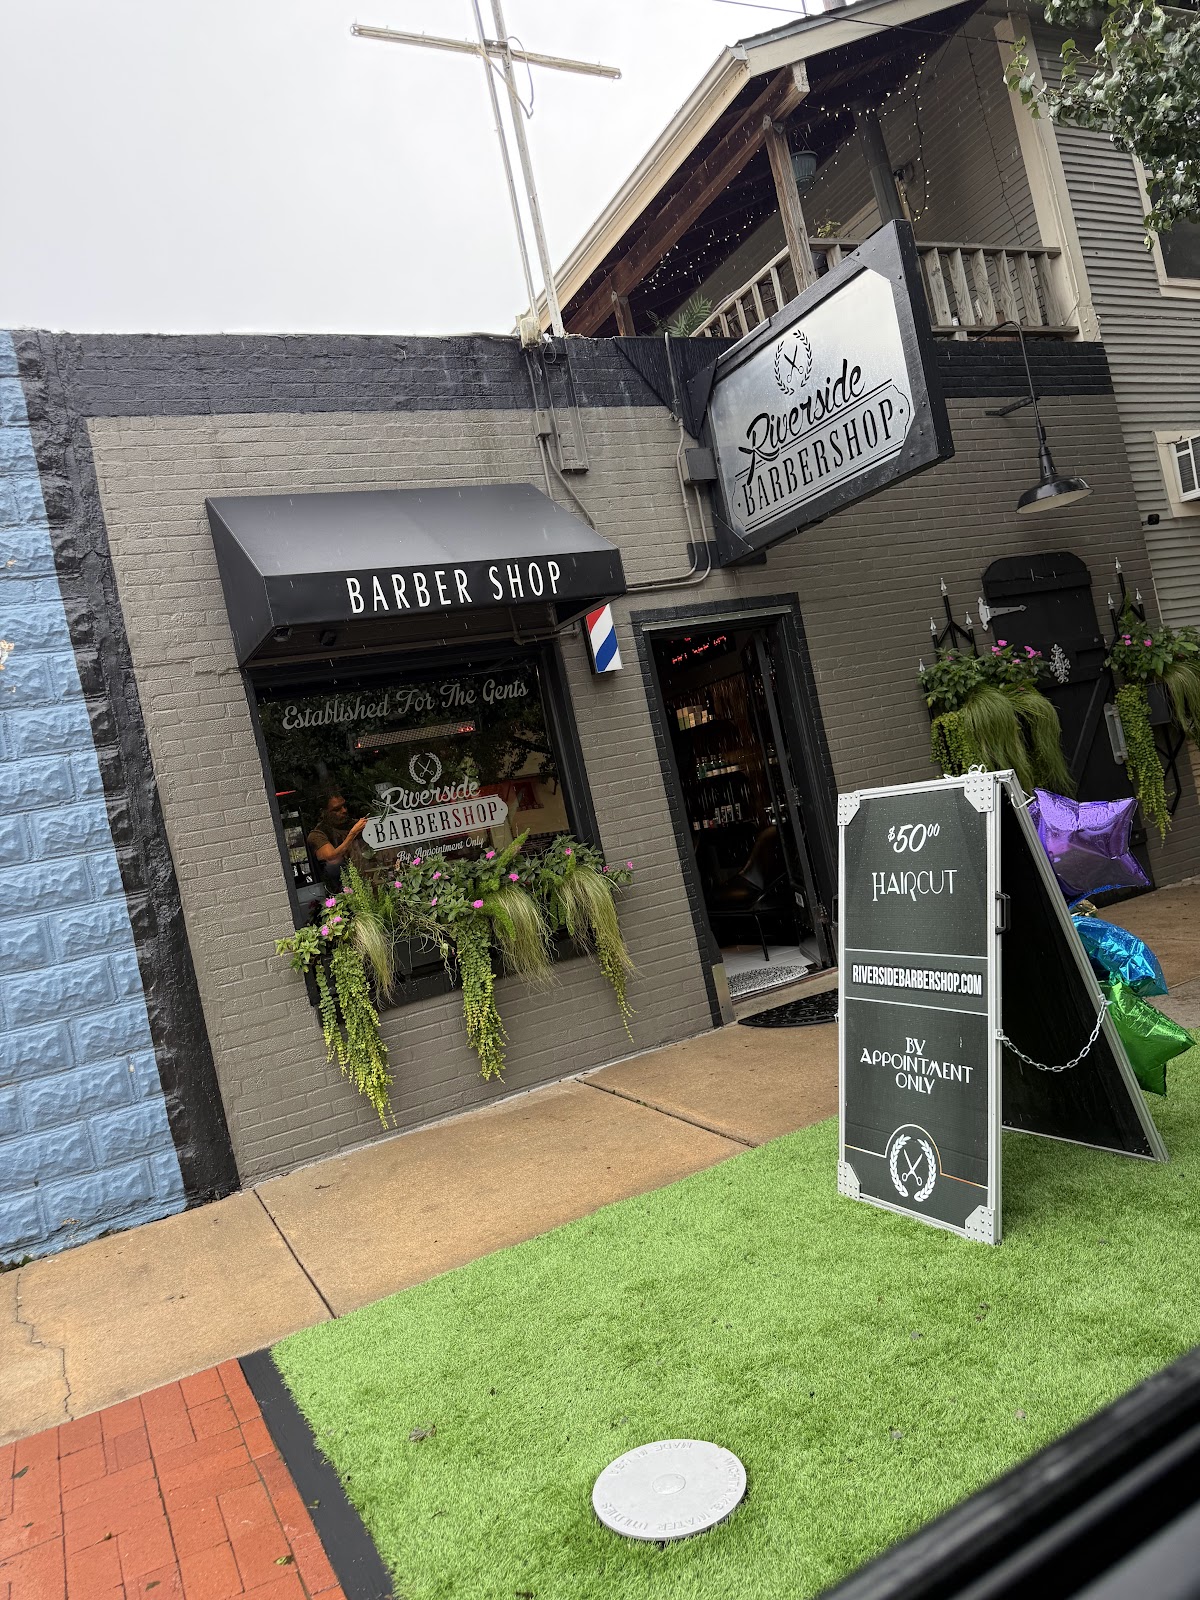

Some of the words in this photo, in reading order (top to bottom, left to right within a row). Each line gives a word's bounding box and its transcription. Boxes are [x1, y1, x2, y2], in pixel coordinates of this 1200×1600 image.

[738, 358, 865, 484] Riverside
[741, 397, 895, 518] BARBERSHOP
[346, 568, 473, 615] BARBER
[489, 560, 562, 600] SHOP
[282, 694, 392, 730] Established
[395, 688, 435, 715] For
[438, 682, 478, 708] The
[483, 678, 529, 706] Gents
[372, 776, 481, 823] Riverside
[374, 800, 498, 844] BARBERSHOP
[396, 850, 412, 864] By
[413, 840, 465, 861] Appointment
[465, 835, 486, 850] Only
[871, 868, 958, 902] HAIRCUT
[852, 964, 983, 996] RIVERSIDEBARBERSHOP.COM
[859, 1046, 974, 1084] APPOINTMENT
[904, 1036, 926, 1054] BY
[895, 1073, 934, 1094] ONLY
